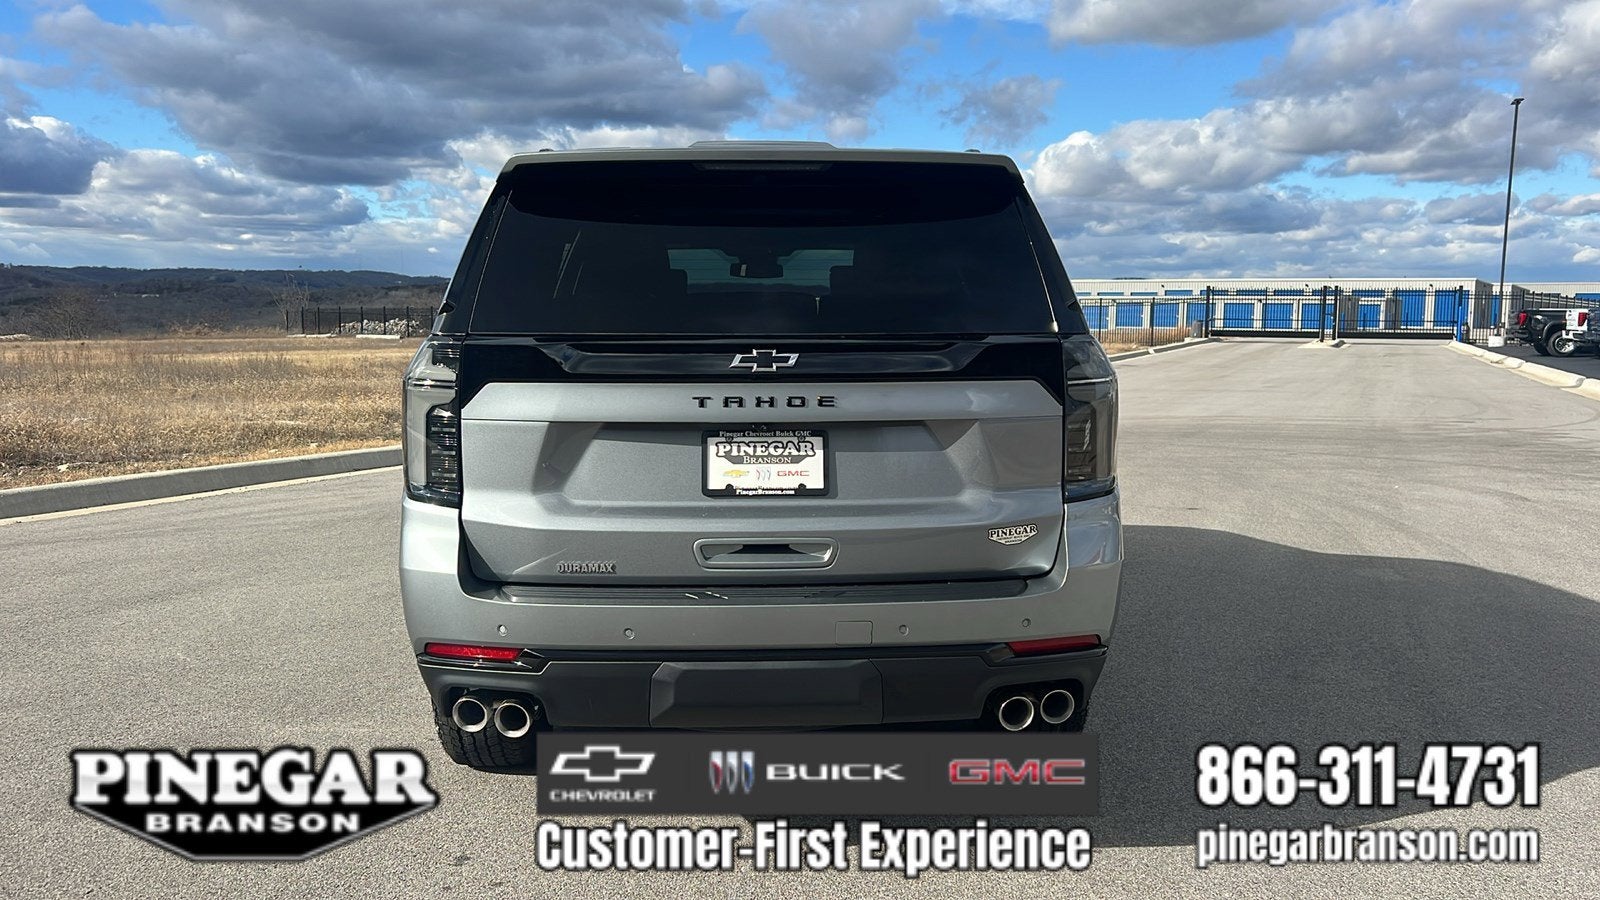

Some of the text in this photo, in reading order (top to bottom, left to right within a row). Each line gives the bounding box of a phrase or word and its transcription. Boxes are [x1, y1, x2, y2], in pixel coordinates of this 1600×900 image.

[692, 396, 836, 408] TAHOE
[719, 430, 743, 438] Pinegar
[716, 441, 816, 457] PINEGAR
[743, 456, 792, 464] BRANSON
[990, 525, 1037, 538] PINEGAR
[557, 562, 616, 574] DURAMAX
